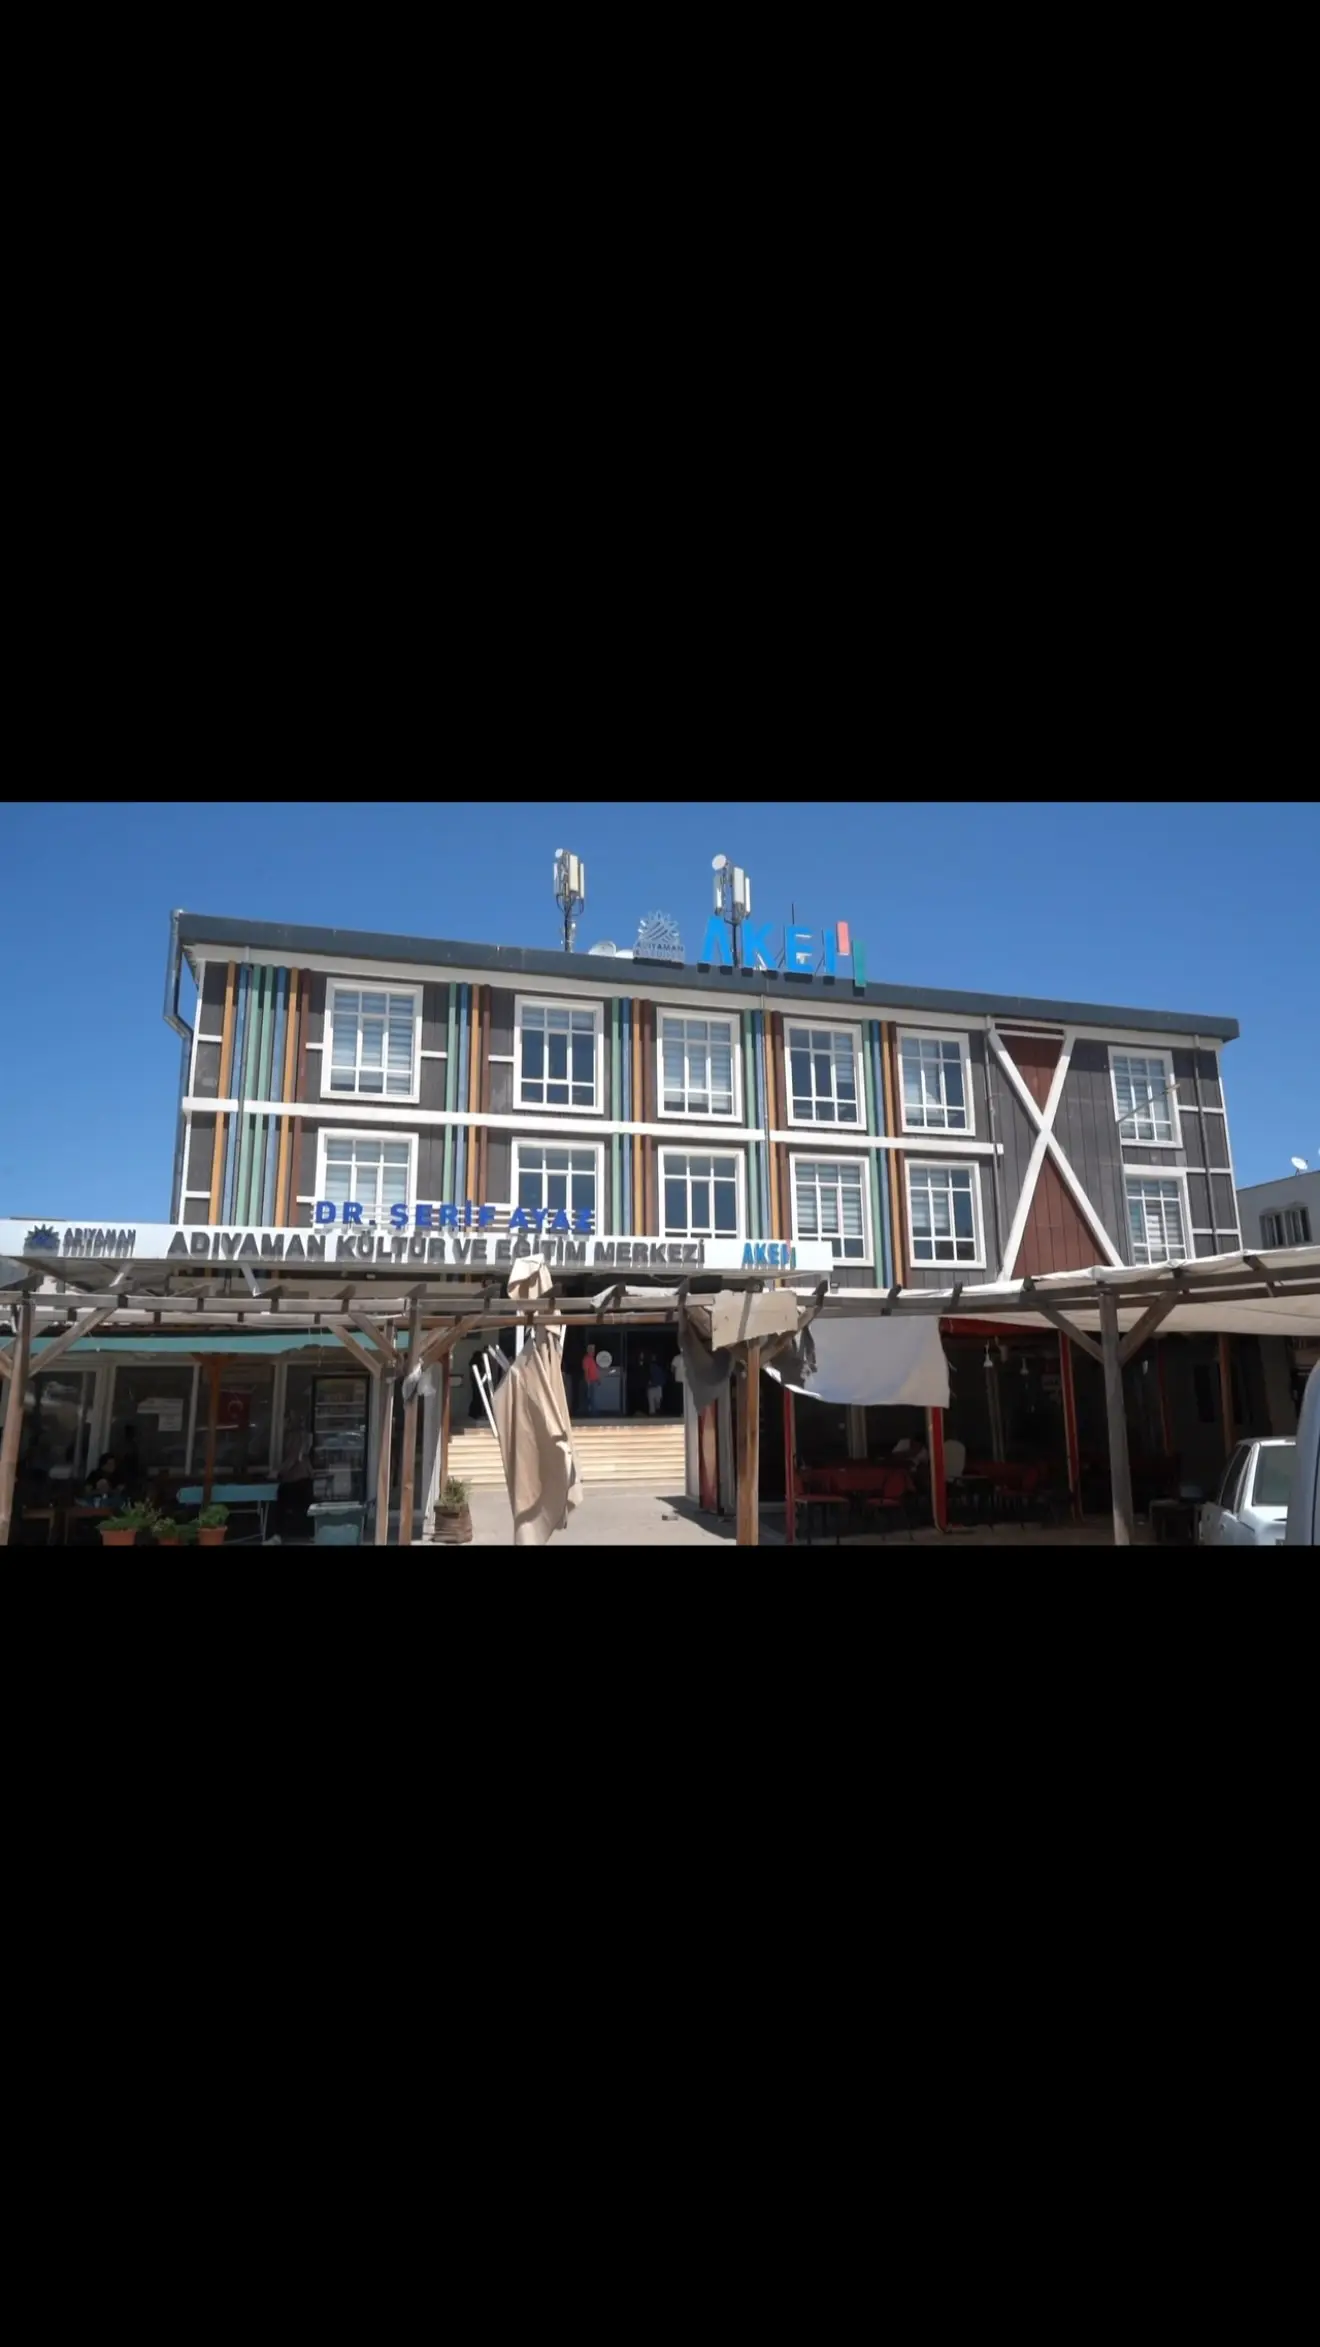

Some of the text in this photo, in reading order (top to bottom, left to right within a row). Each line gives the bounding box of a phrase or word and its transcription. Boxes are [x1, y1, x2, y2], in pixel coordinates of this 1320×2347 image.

[315, 1200, 593, 1232] DR. ŞERİF AYAZ
[166, 1231, 326, 1258] ADIYAMAN
[336, 1230, 446, 1258] KÜLTÜR
[453, 1238, 488, 1260] VE
[496, 1234, 586, 1261] EĞİTİM
[594, 1238, 706, 1264] MERKEZİ
